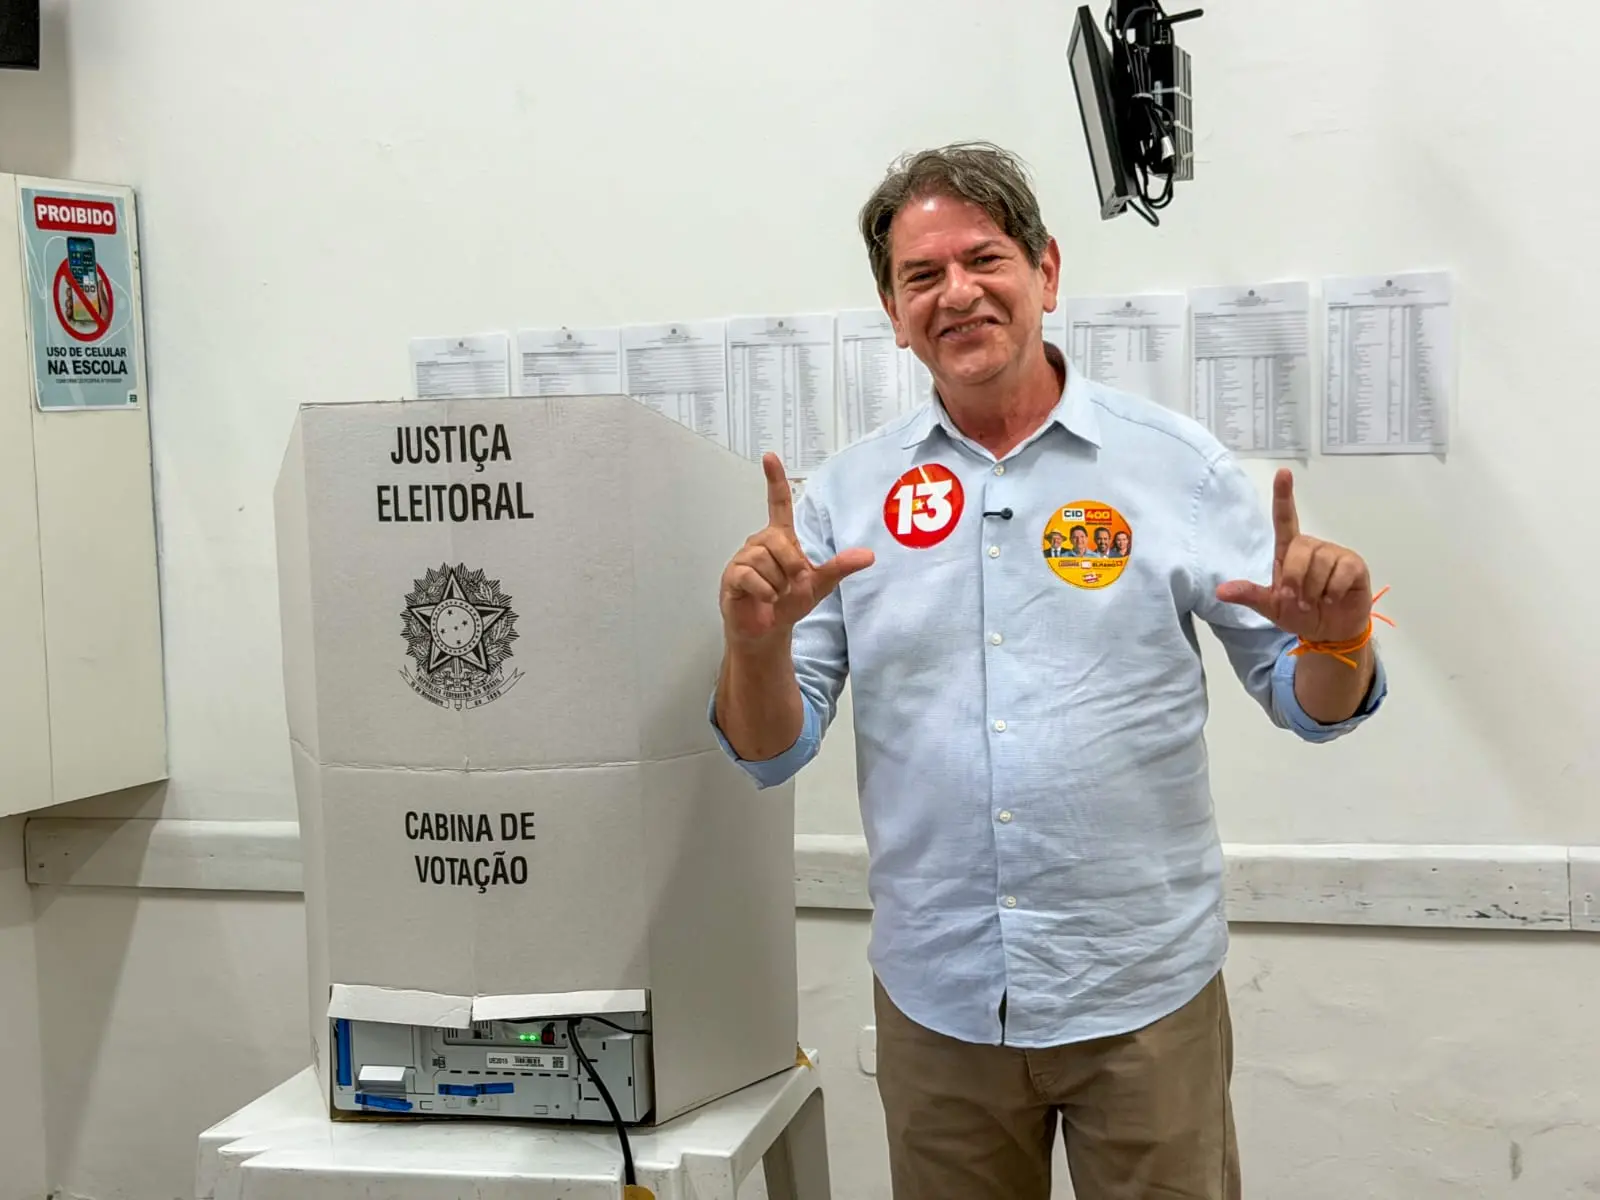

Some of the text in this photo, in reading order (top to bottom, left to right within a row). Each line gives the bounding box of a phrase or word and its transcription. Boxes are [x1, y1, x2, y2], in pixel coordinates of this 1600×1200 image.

[36, 204, 114, 226] PROIBIDO
[46, 347, 128, 357] USO DE CELULAR
[47, 360, 128, 375] NA ESCOLA
[390, 424, 512, 473] JUSTIÇA
[376, 481, 534, 522] ELEITORAL
[892, 479, 953, 535] 13
[1063, 509, 1110, 520] CID 400
[405, 811, 536, 842] CABINA DE
[414, 850, 528, 893] VOTAÇÃO
